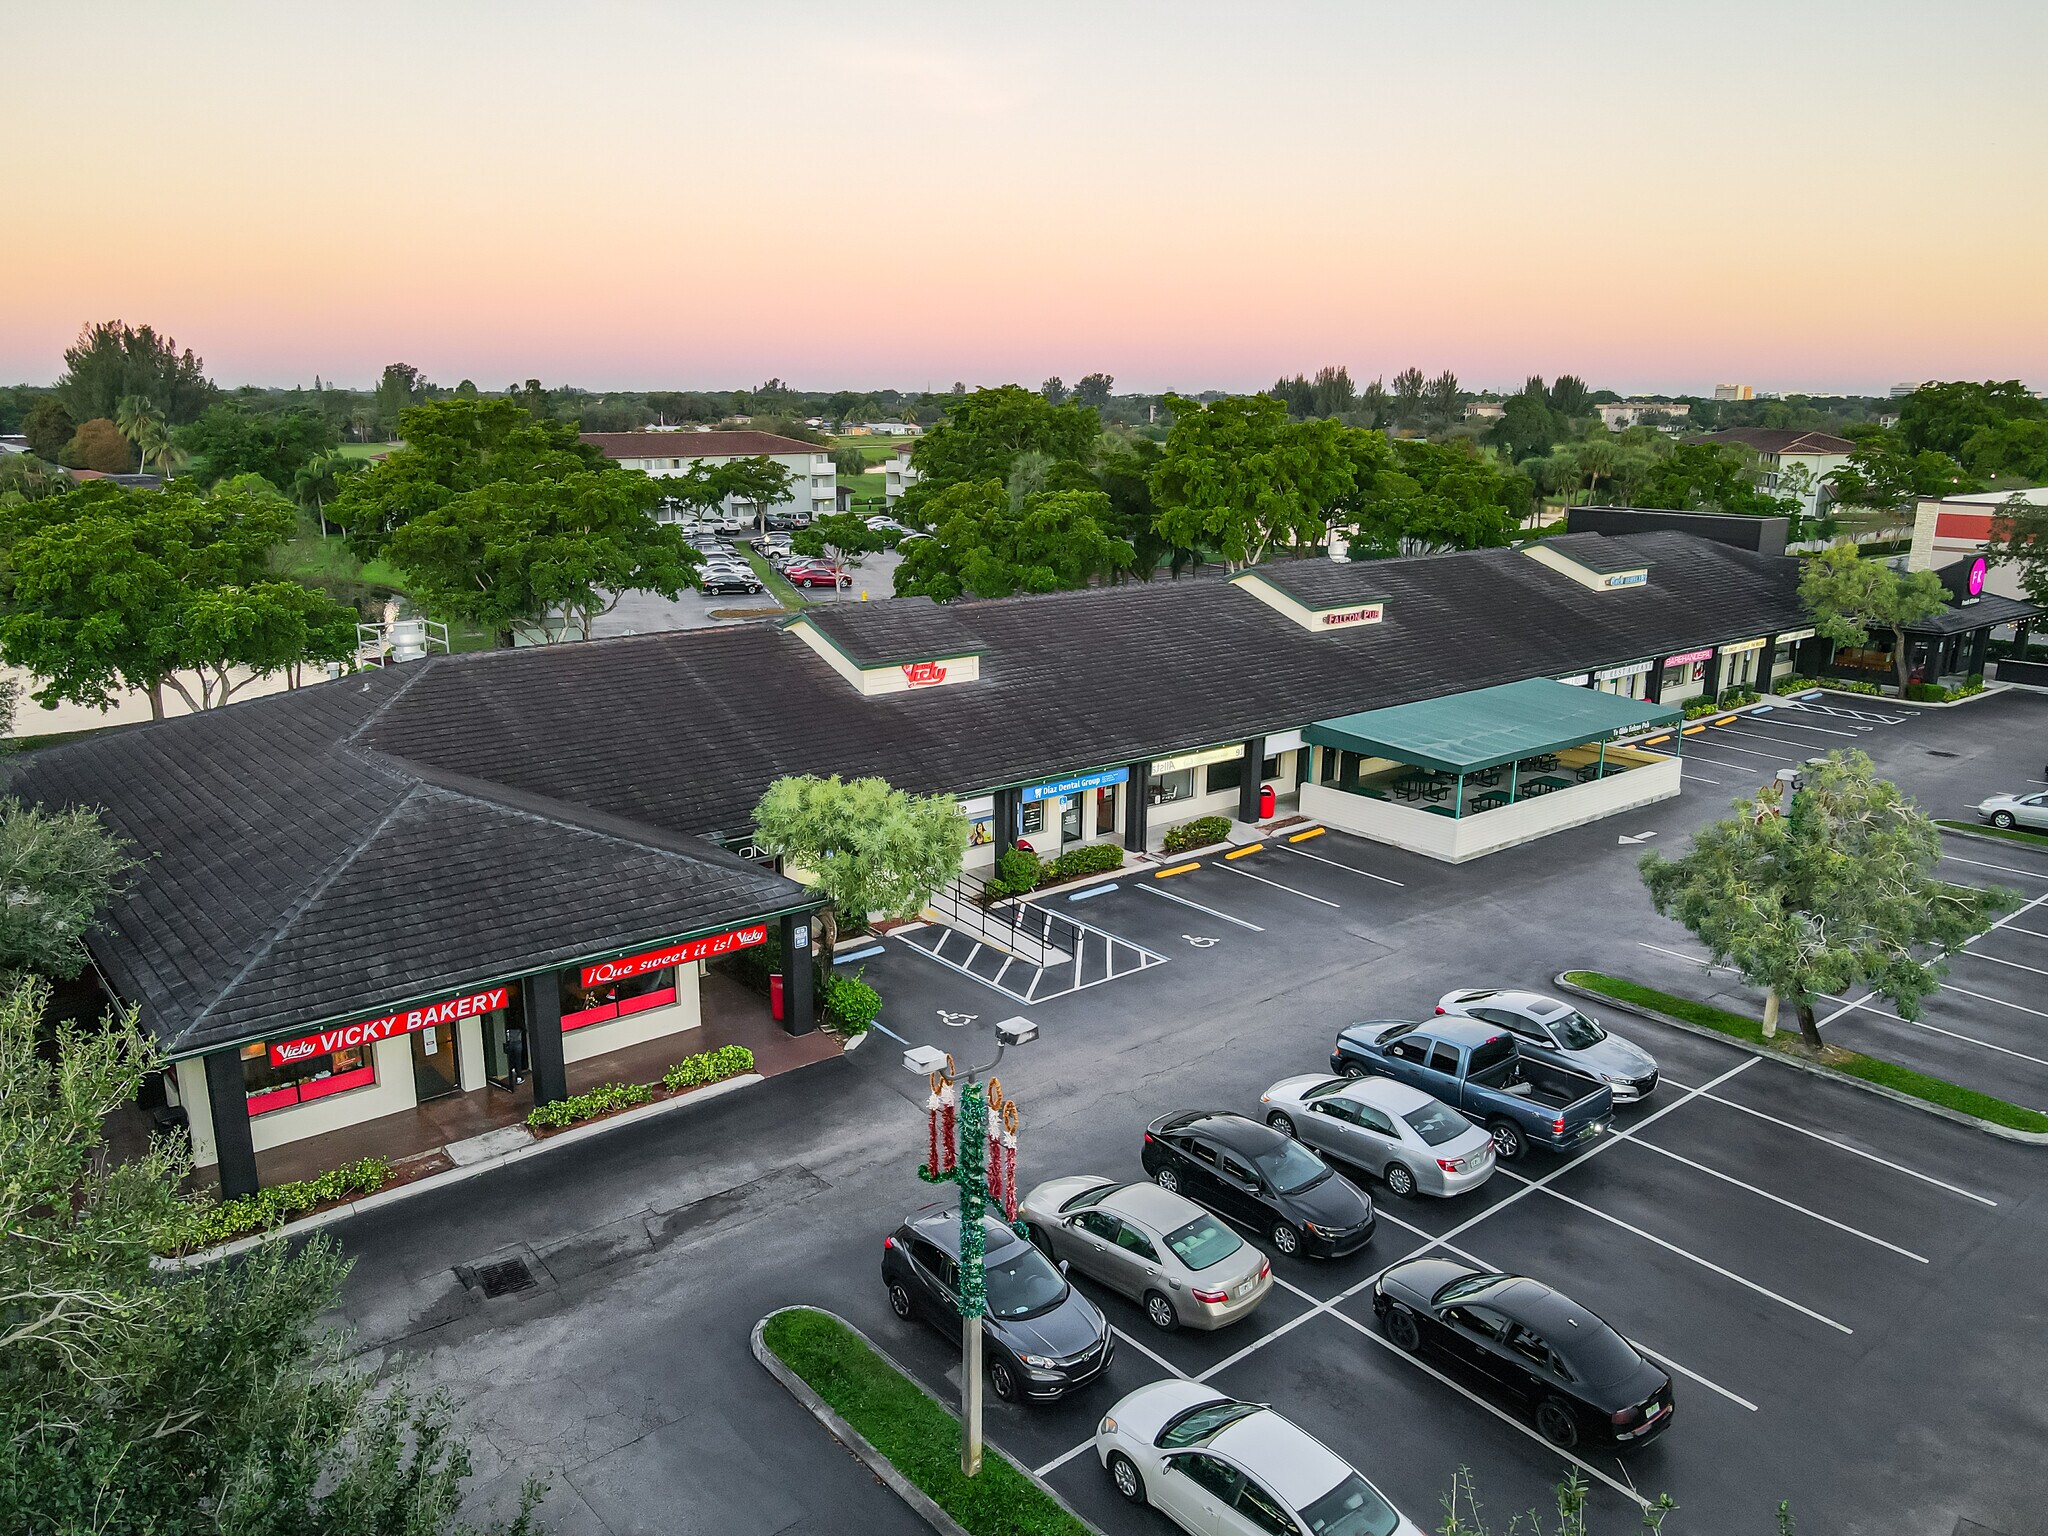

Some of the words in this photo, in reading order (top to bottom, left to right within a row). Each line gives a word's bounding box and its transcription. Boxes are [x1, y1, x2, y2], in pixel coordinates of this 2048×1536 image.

[1972, 570, 1982, 585] FK
[1328, 612, 1361, 625] FALCON
[1363, 609, 1379, 620] PUB
[902, 661, 947, 688] Vicky
[1058, 780, 1080, 791] Dental
[1081, 777, 1101, 787] Group
[639, 948, 687, 971] sweet
[694, 943, 707, 957] it
[713, 934, 734, 952] is!
[736, 929, 764, 946] Vicky
[276, 1040, 316, 1063] Vicky
[320, 1016, 396, 1052] VICKY
[406, 989, 503, 1031] BAKERY
